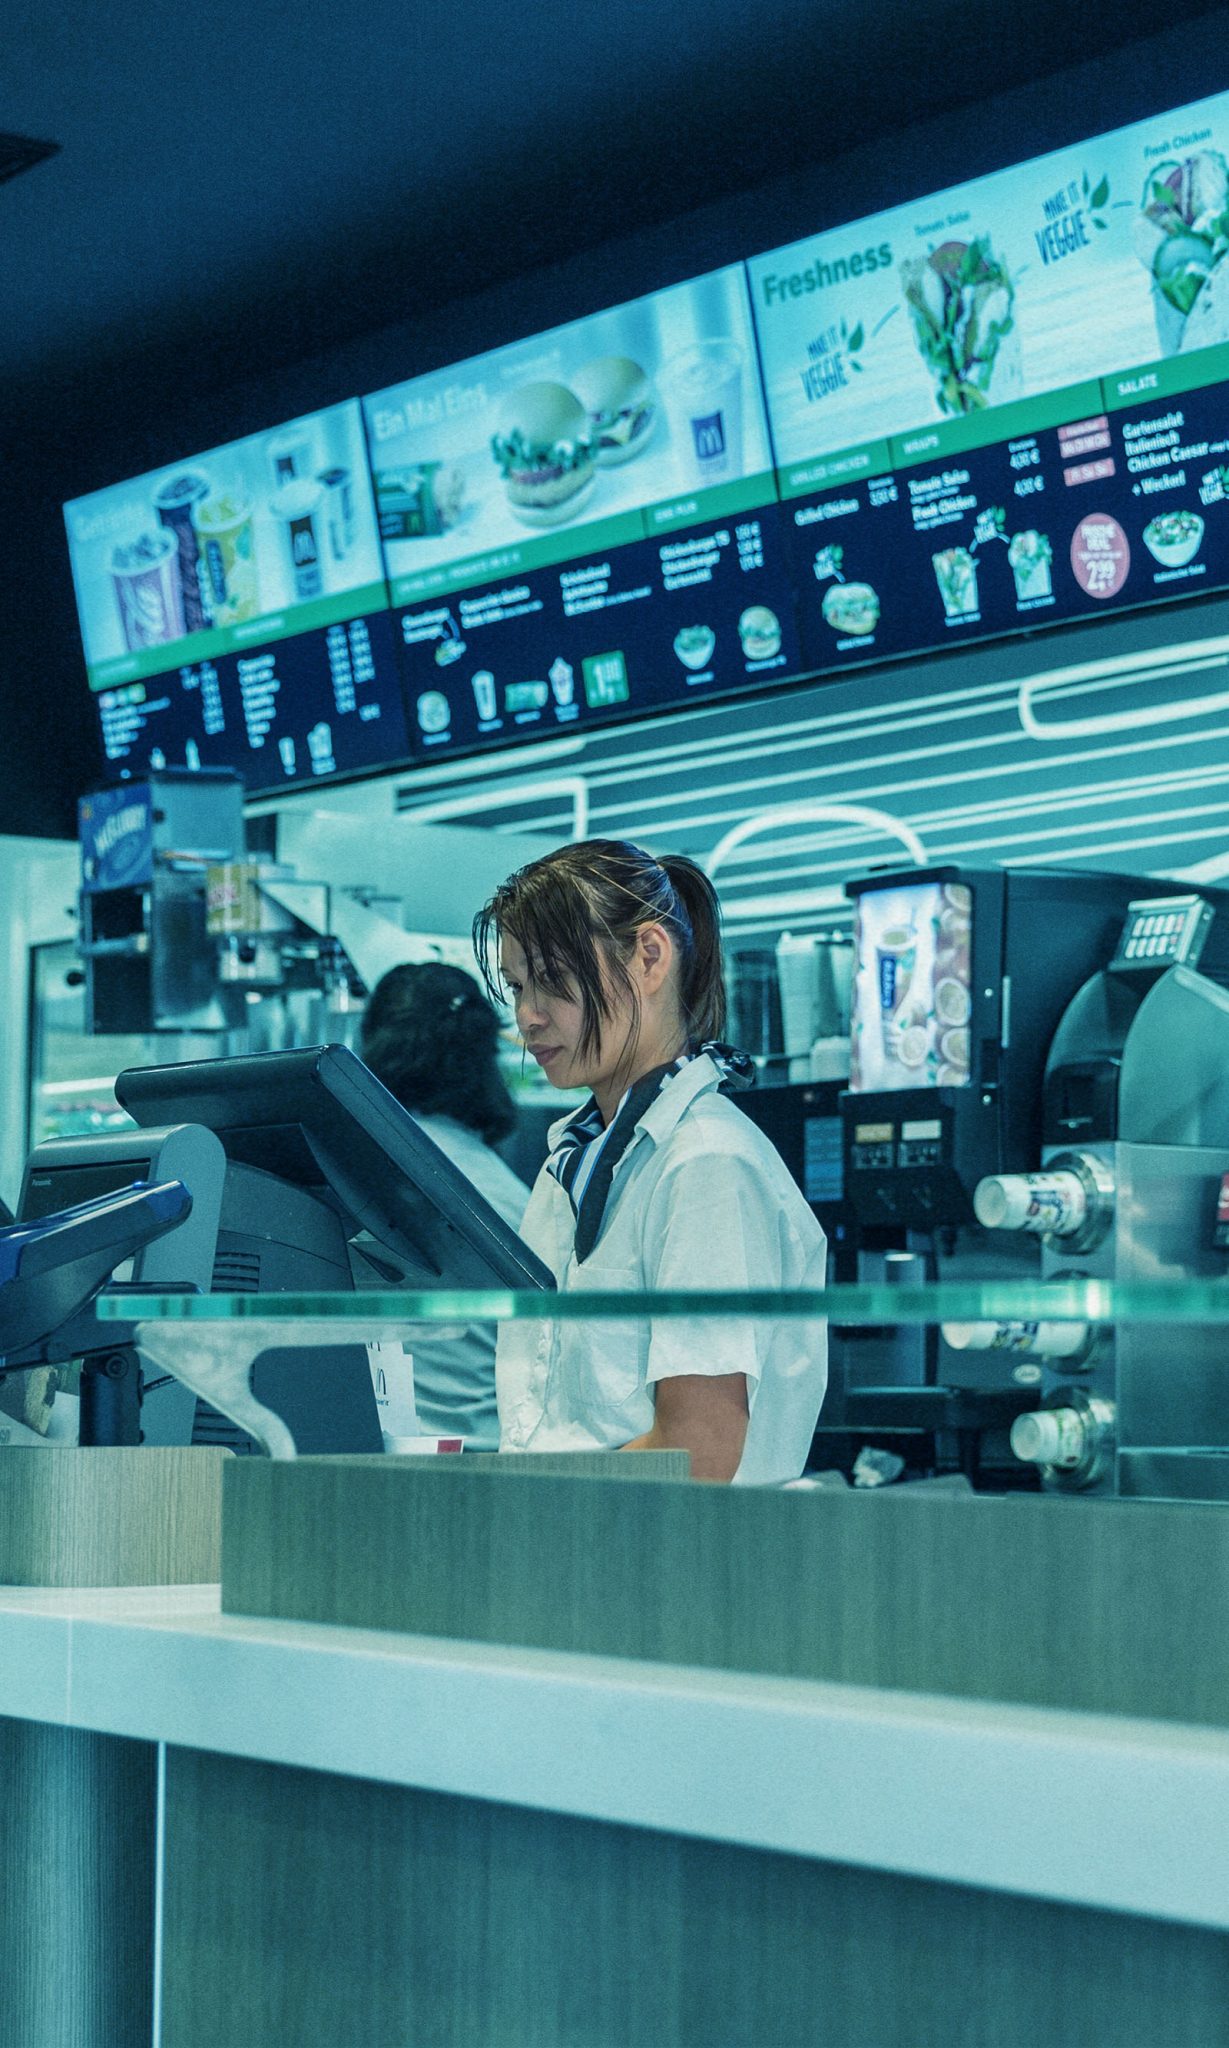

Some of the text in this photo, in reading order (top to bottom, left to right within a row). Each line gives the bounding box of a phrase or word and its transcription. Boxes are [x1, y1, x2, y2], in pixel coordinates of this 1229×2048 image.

[1034, 210, 1090, 266] VEGGIE
[762, 242, 893, 306] Freshness
[800, 352, 849, 402] VEGGIE
